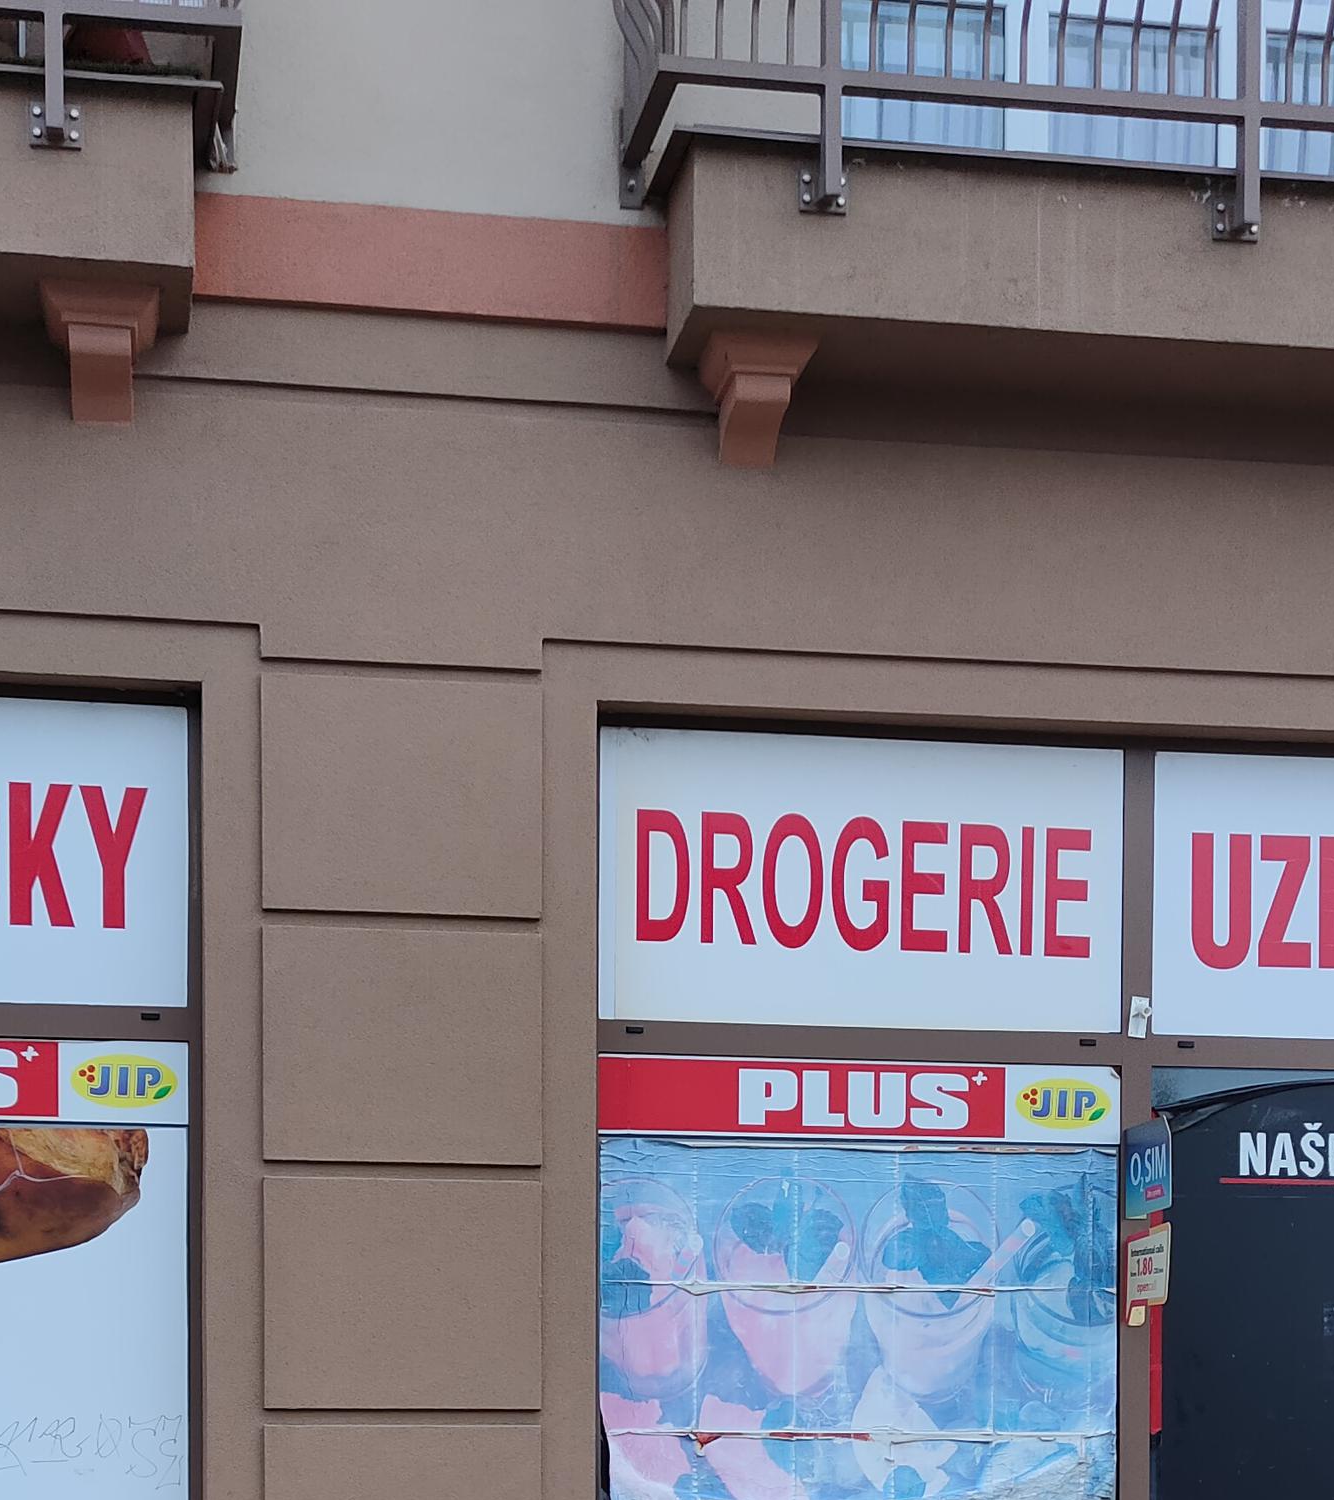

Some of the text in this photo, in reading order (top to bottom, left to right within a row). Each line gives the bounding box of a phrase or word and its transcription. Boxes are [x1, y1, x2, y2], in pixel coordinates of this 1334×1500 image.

[636, 808, 1093, 958] DROGERIE
[85, 1063, 163, 1098] JIP
[1028, 1087, 1096, 1121] JIP
